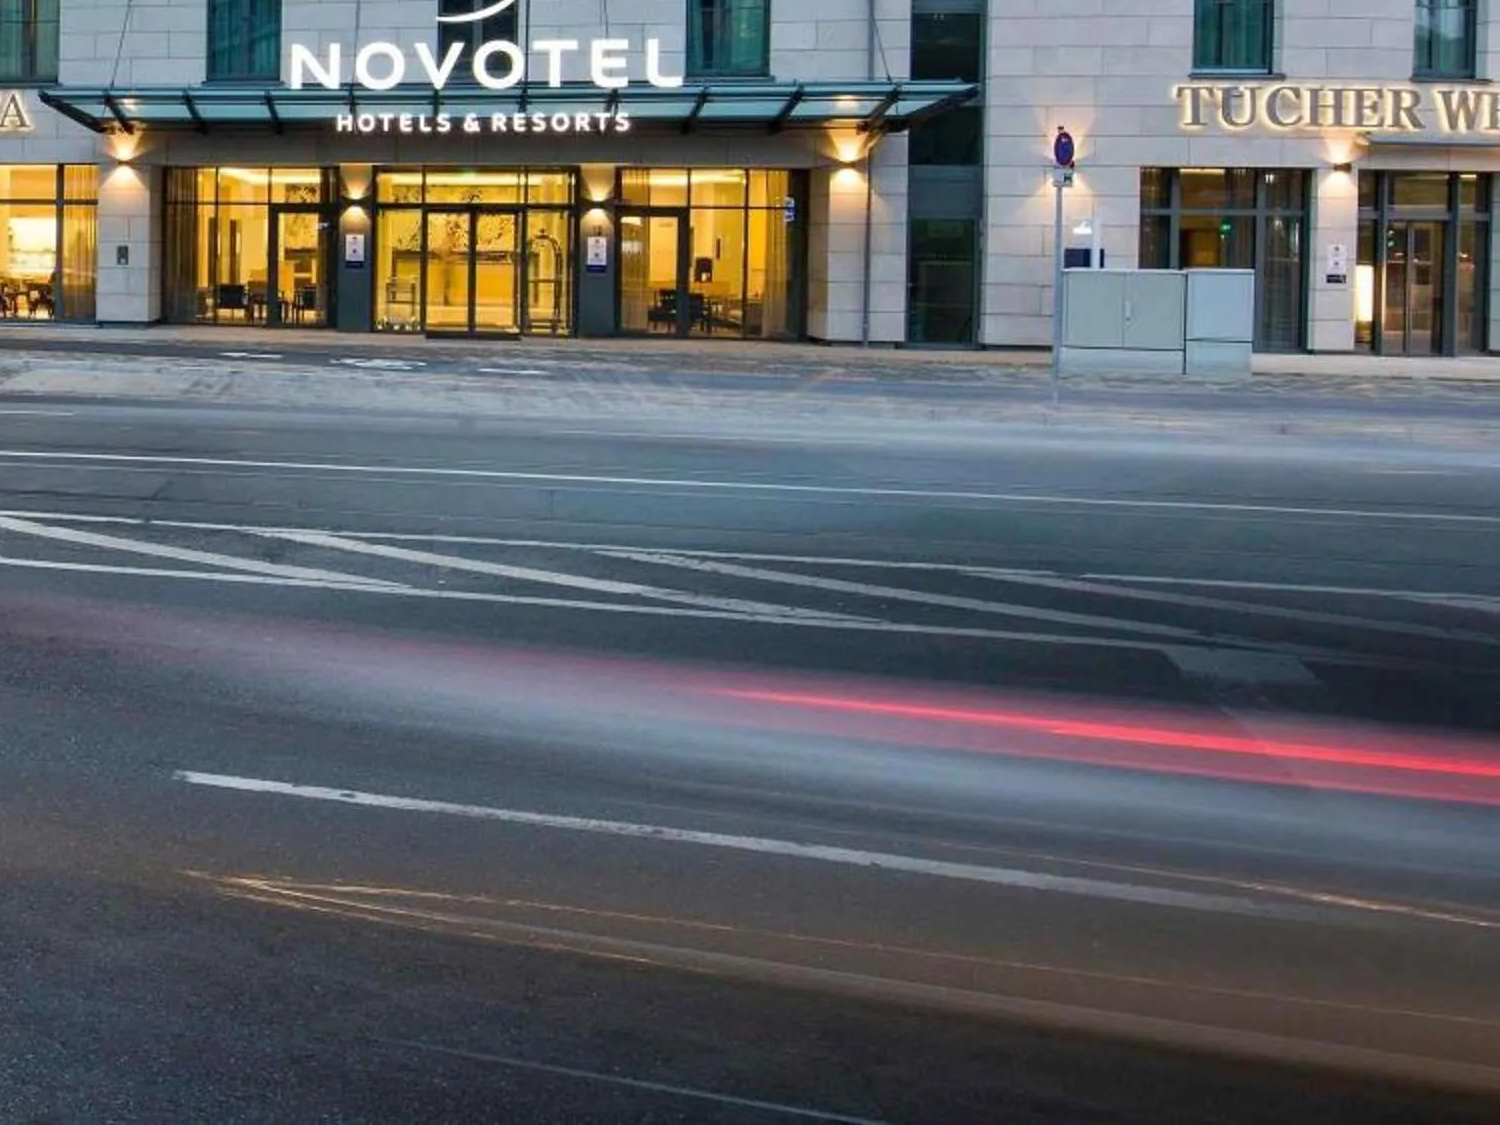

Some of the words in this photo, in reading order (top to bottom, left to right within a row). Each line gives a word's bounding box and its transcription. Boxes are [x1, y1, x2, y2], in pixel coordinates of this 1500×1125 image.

[290, 38, 684, 89] NOVOTEL
[336, 112, 452, 133] HOTELS
[463, 112, 481, 133] &
[492, 111, 632, 132] RESORTS
[1176, 86, 1426, 130] TUCHER
